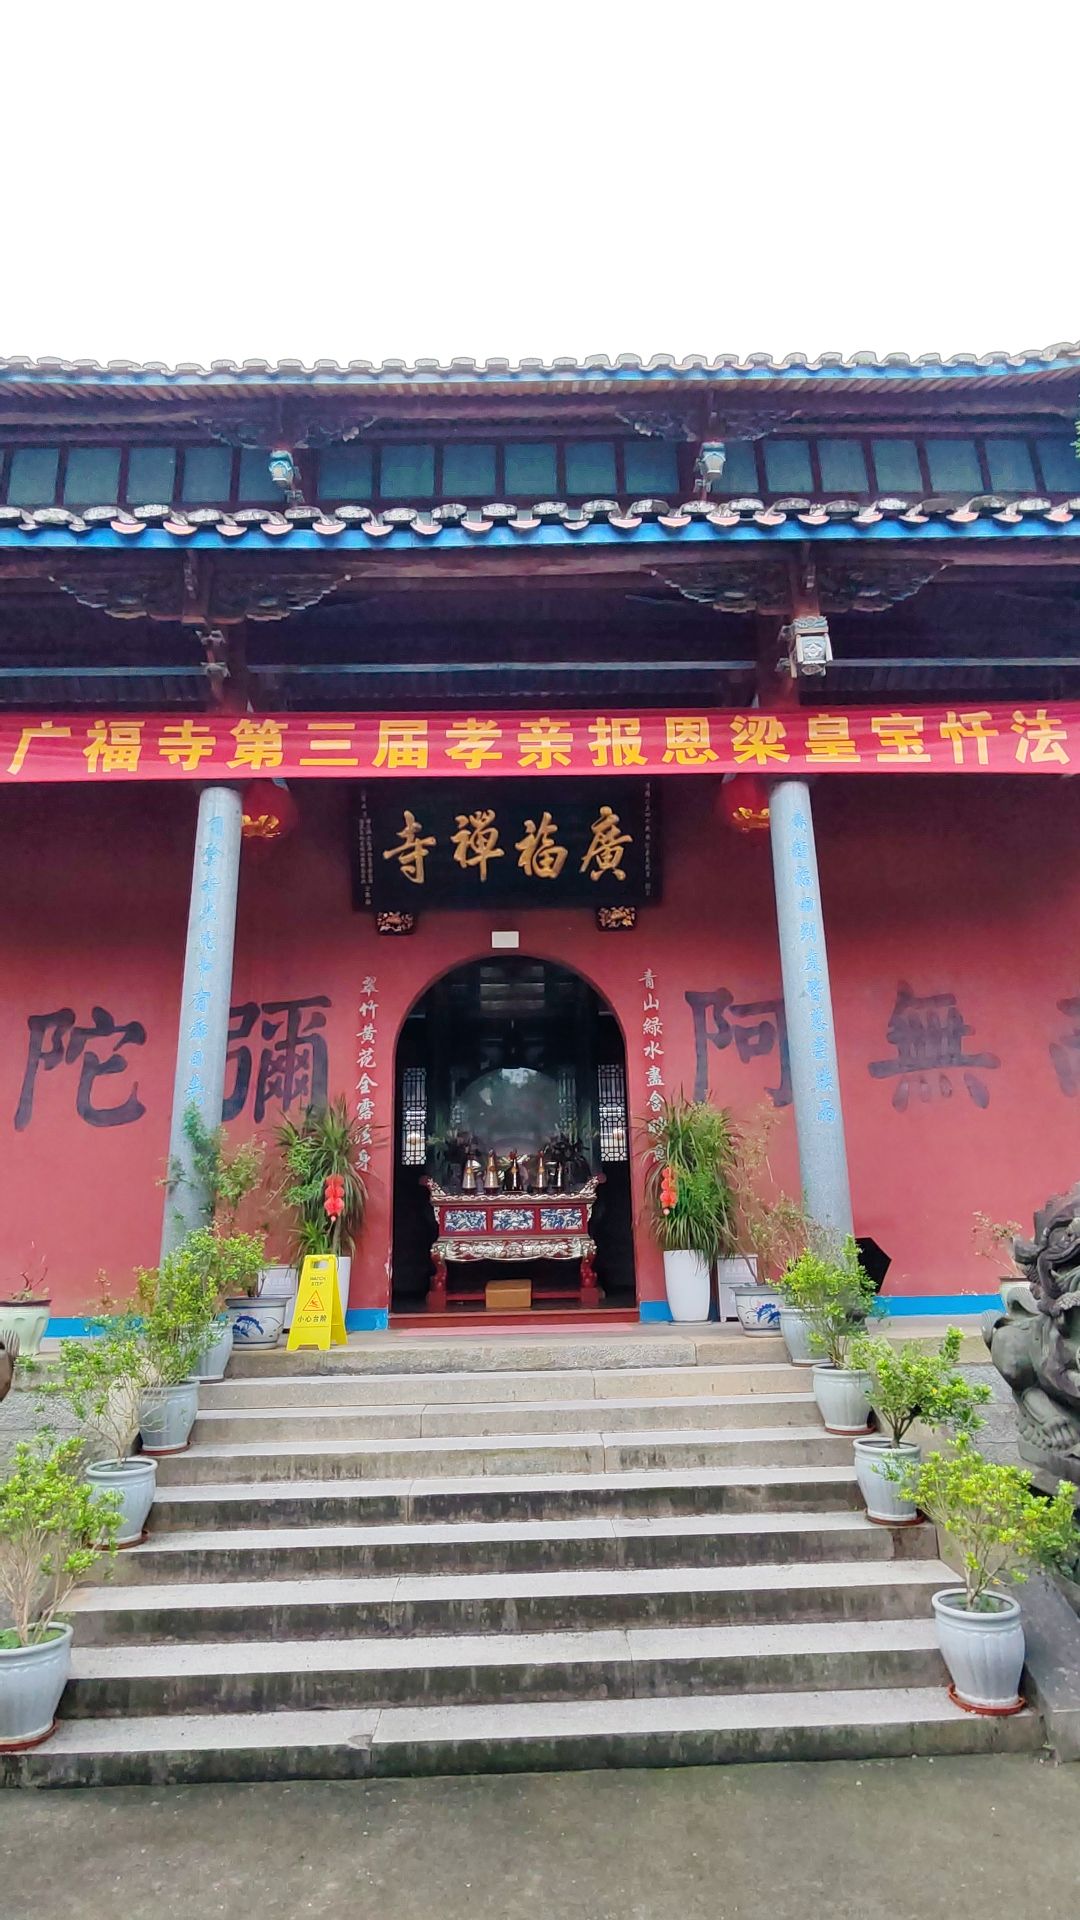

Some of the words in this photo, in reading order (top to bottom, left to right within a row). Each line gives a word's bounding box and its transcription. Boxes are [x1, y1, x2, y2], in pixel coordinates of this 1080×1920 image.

[7, 709, 1071, 775] 广福寺第三届孝亲报恩梁皇宝忏法
[382, 805, 634, 884] 廣福禪寺
